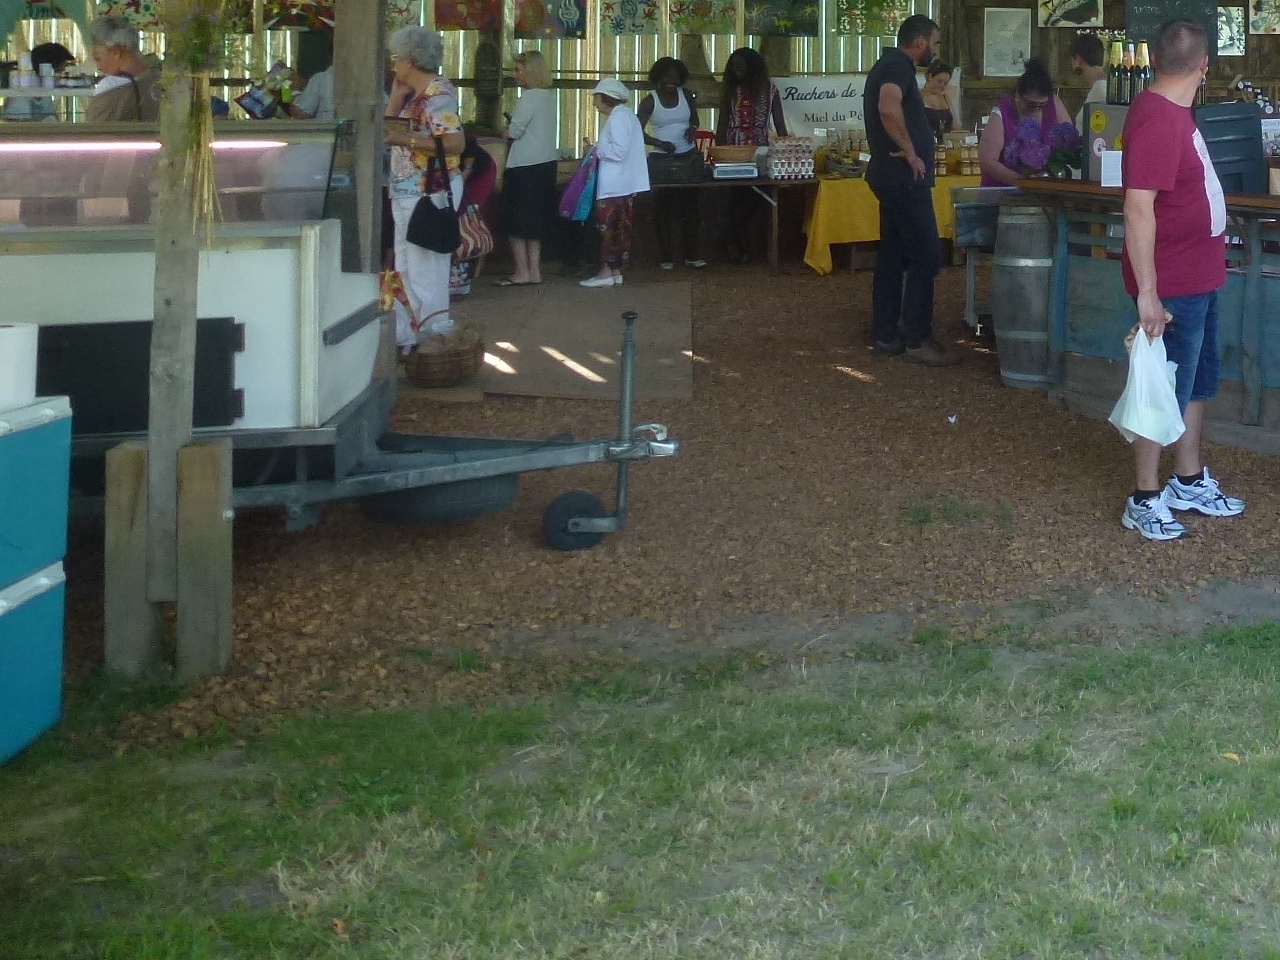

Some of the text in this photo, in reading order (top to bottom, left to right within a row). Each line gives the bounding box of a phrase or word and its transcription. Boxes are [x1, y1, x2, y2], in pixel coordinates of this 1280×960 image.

[782, 85, 838, 101] Ruchers
[841, 83, 858, 98] de
[803, 112, 828, 123] Miel
[832, 111, 846, 122] du
